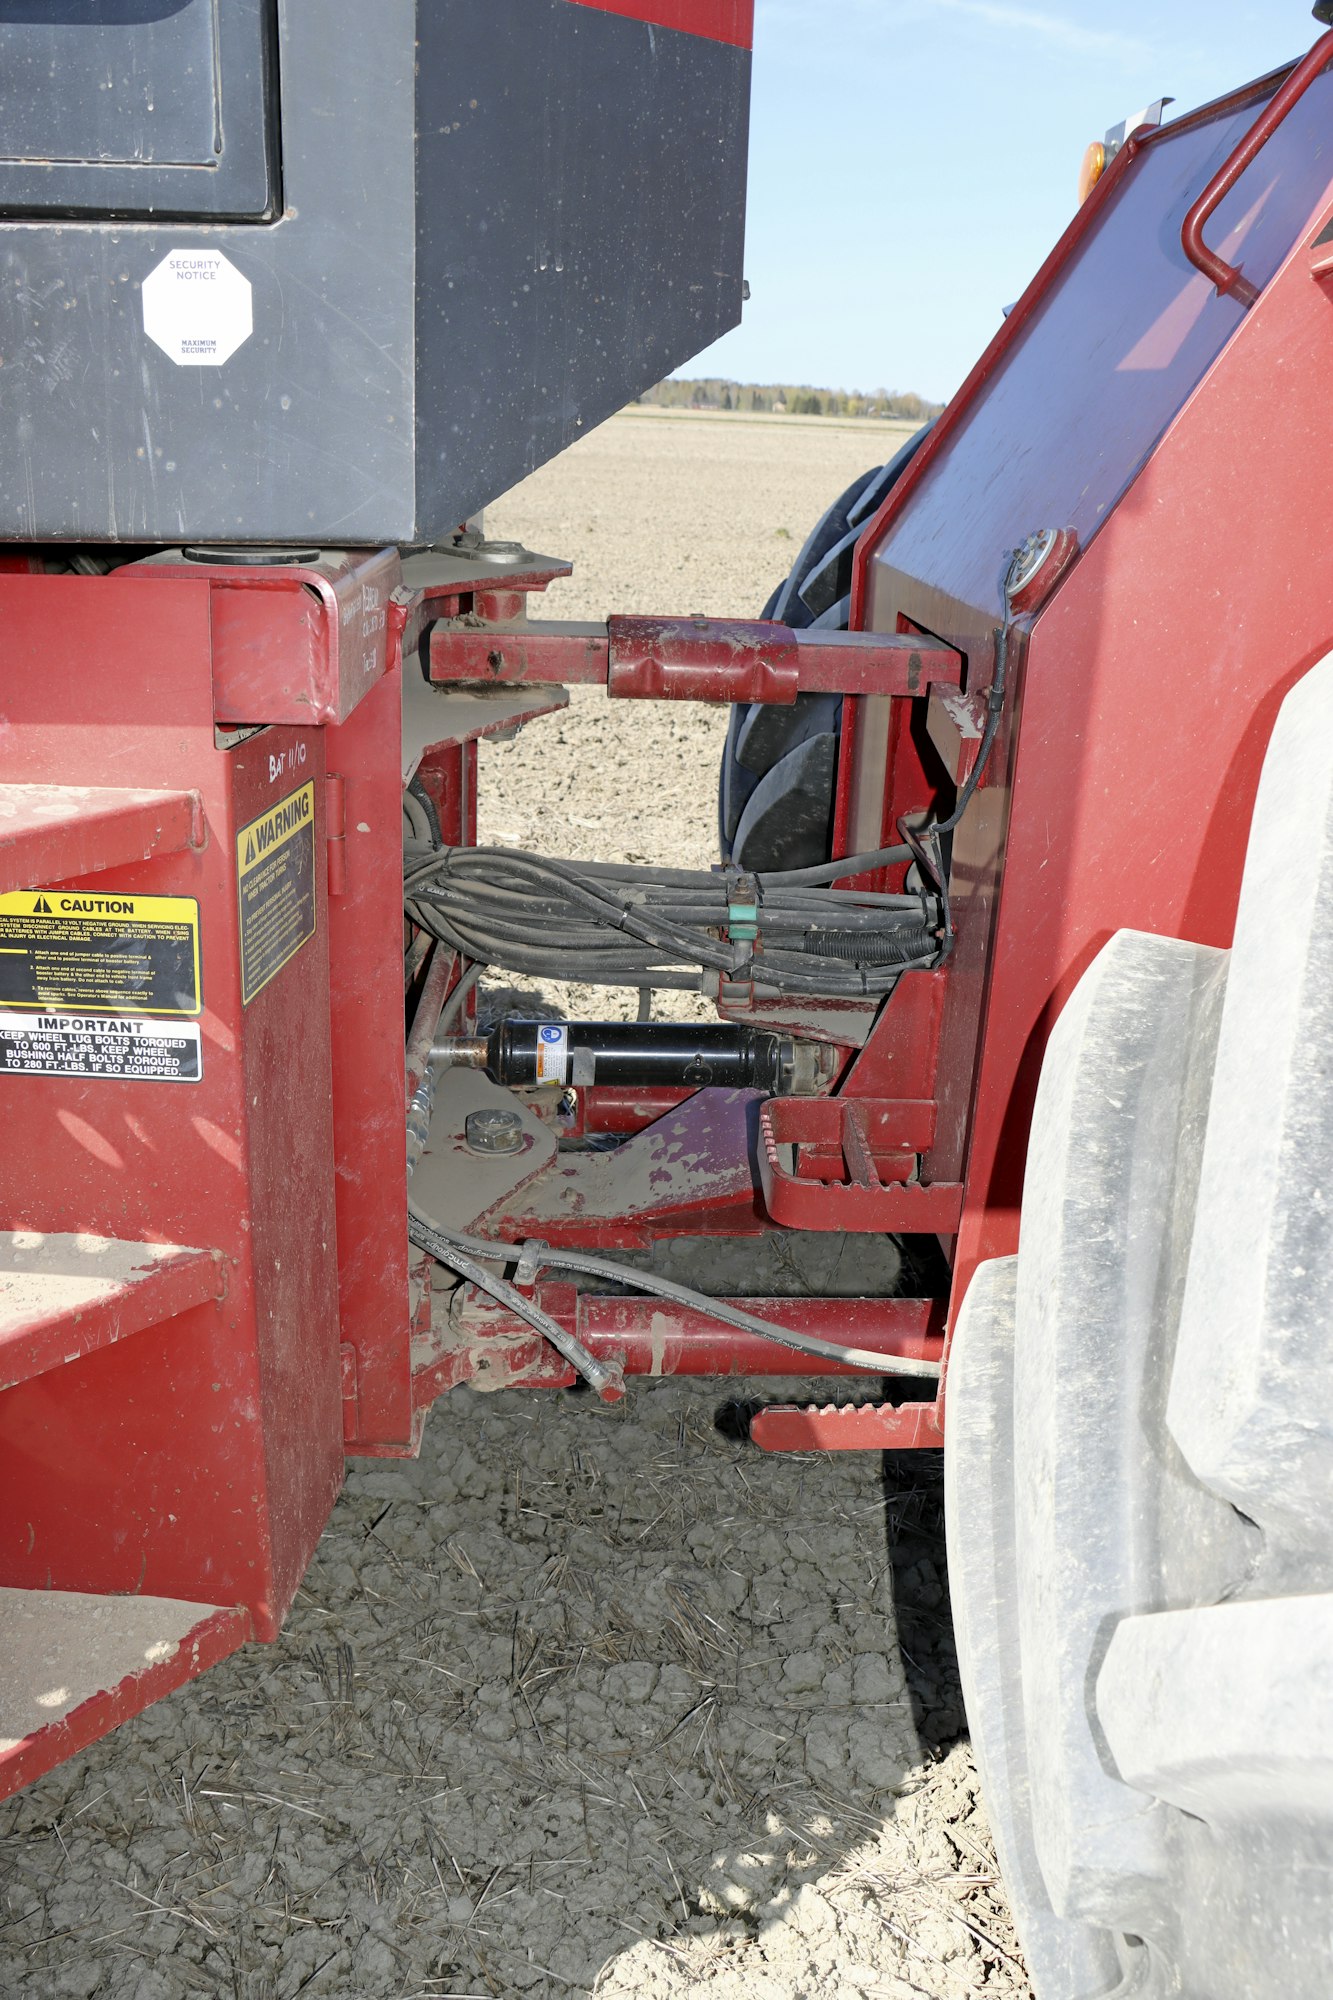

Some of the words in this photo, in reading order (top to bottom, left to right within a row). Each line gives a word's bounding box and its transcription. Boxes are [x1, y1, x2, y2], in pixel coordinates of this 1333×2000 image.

[169, 260, 220, 270] SECURITY
[176, 271, 216, 280] NOTICE
[256, 792, 309, 852] WARNING
[60, 899, 134, 914] CAUTION
[38, 1017, 144, 1034] IMPORTANT
[0, 1031, 25, 1040] KEEP
[28, 1032, 66, 1042] WHEEL
[69, 1034, 92, 1043] LUG
[95, 1036, 130, 1046] BOLTS
[133, 1037, 187, 1048] TORQUED
[6, 1049, 54, 1060] BUSHING
[58, 1052, 85, 1061] HALF
[89, 1054, 124, 1064] BOLTS
[127, 1056, 180, 1066] TORQUED
[14, 1041, 29, 1050] TO
[32, 1042, 50, 1051] 600
[54, 1043, 97, 1053] FT.-LBS.
[101, 1045, 129, 1055] KEEP
[133, 1047, 171, 1057] WHEEL
[5, 1059, 21, 1068] TO
[24, 1060, 42, 1069] 280
[46, 1061, 89, 1071] FT.-LBS.
[93, 1063, 102, 1072] IF
[106, 1064, 121, 1073] SO
[125, 1065, 182, 1076] EQUIPPED.
